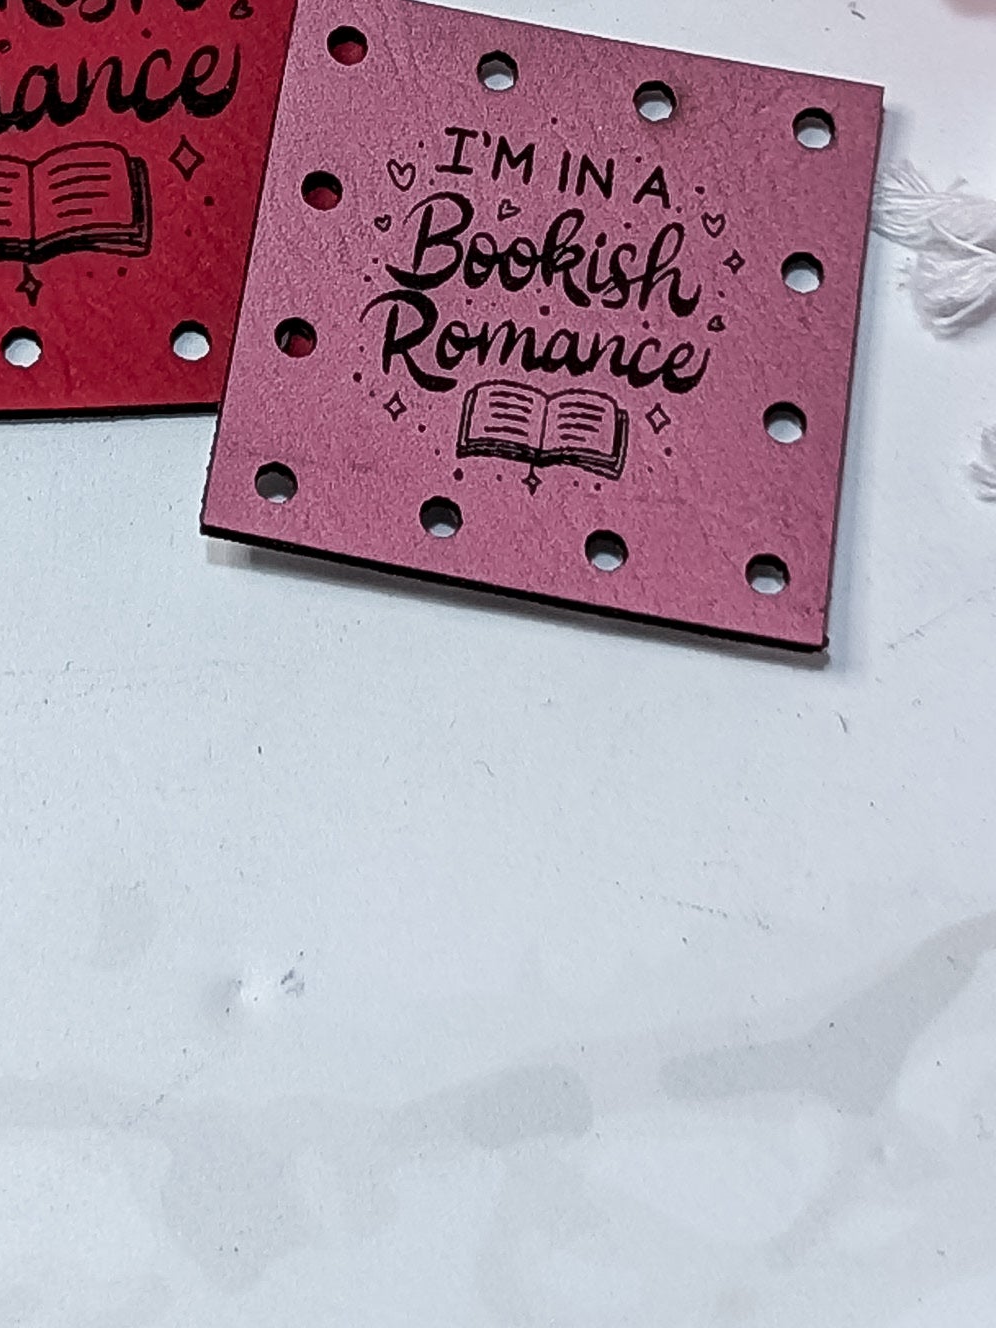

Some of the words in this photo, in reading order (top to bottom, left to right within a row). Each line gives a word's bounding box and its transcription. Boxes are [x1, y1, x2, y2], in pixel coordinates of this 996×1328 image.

[435, 127, 535, 185] I'M
[558, 151, 614, 199] IN
[633, 166, 671, 209] A
[385, 191, 702, 317] Bookish
[359, 289, 710, 393] Romance
